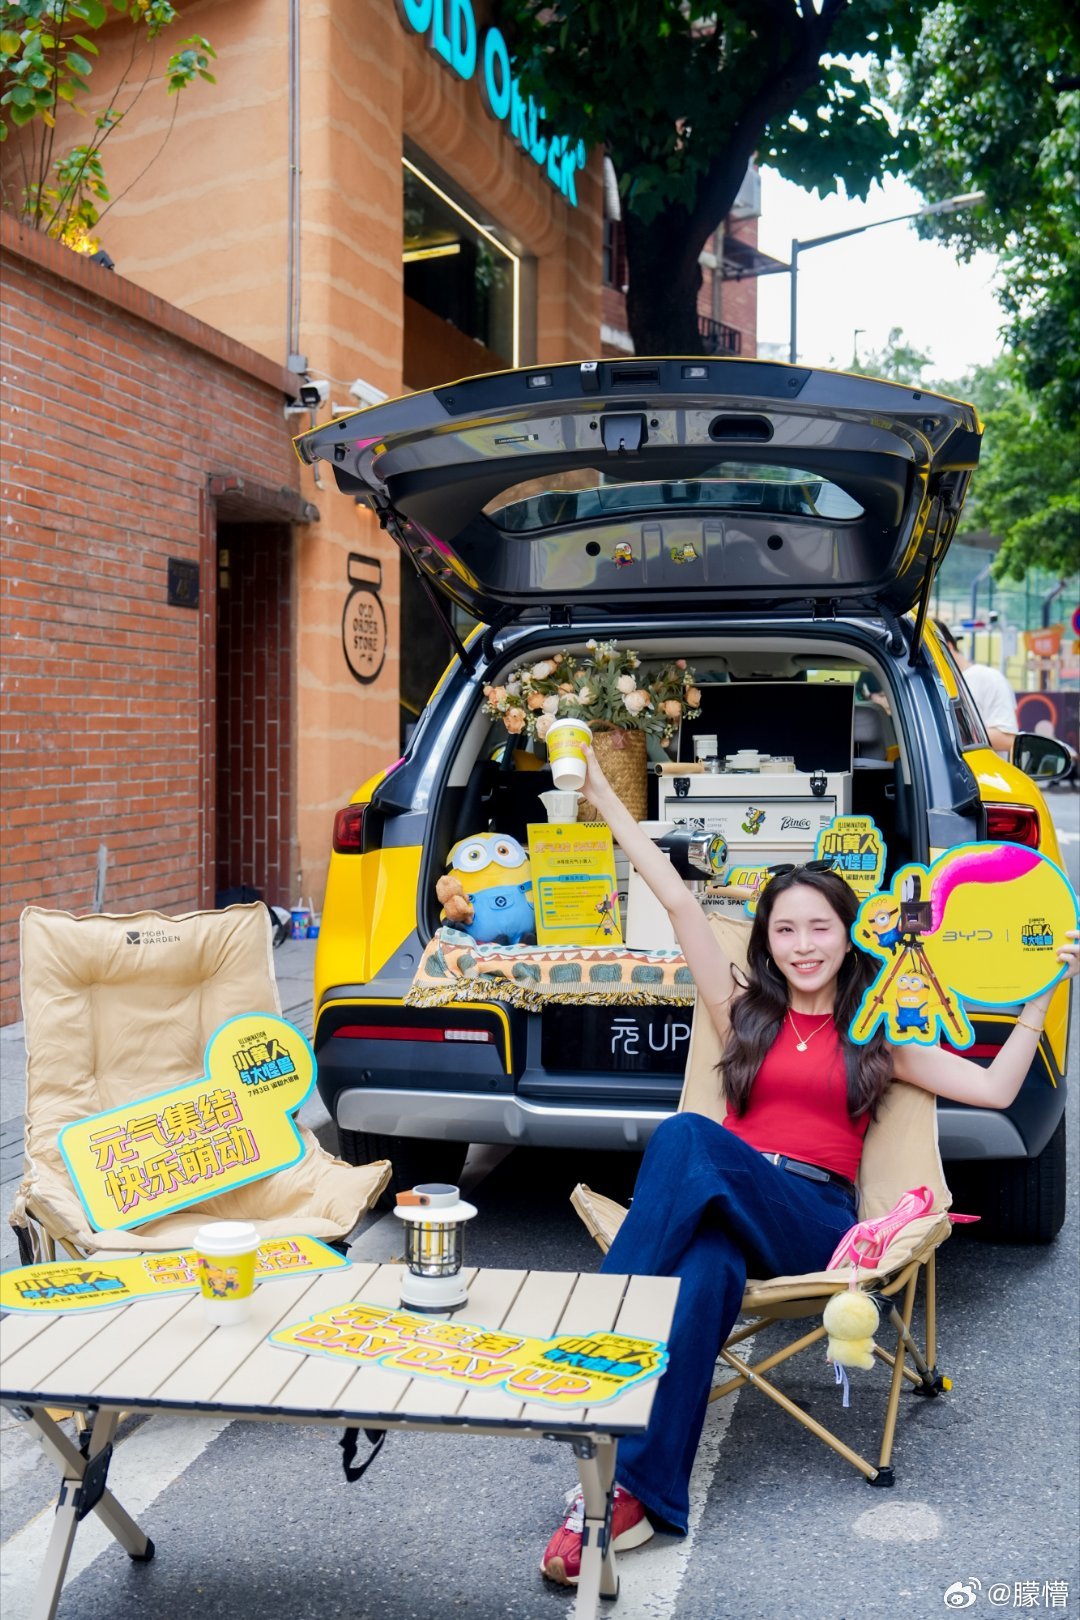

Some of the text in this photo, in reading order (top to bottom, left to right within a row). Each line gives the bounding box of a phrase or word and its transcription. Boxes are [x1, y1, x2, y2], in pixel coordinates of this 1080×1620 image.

[353, 618, 378, 635] ORDER
[354, 635, 378, 652] STORE
[823, 833, 879, 854] 小黄人
[143, 936, 181, 945] GARDEN
[942, 930, 993, 942] BYD
[611, 1018, 691, 1055] 元 UP
[232, 1039, 290, 1071] 小黄人
[239, 1056, 296, 1086] 与大怪兽
[89, 1088, 244, 1171] 元气集结
[104, 1126, 260, 1214] 快乐萌动
[331, 1306, 526, 1358] 元气生活
[294, 1323, 407, 1356] DAY
[395, 1345, 514, 1380] DAY
[507, 1367, 593, 1396] UP
